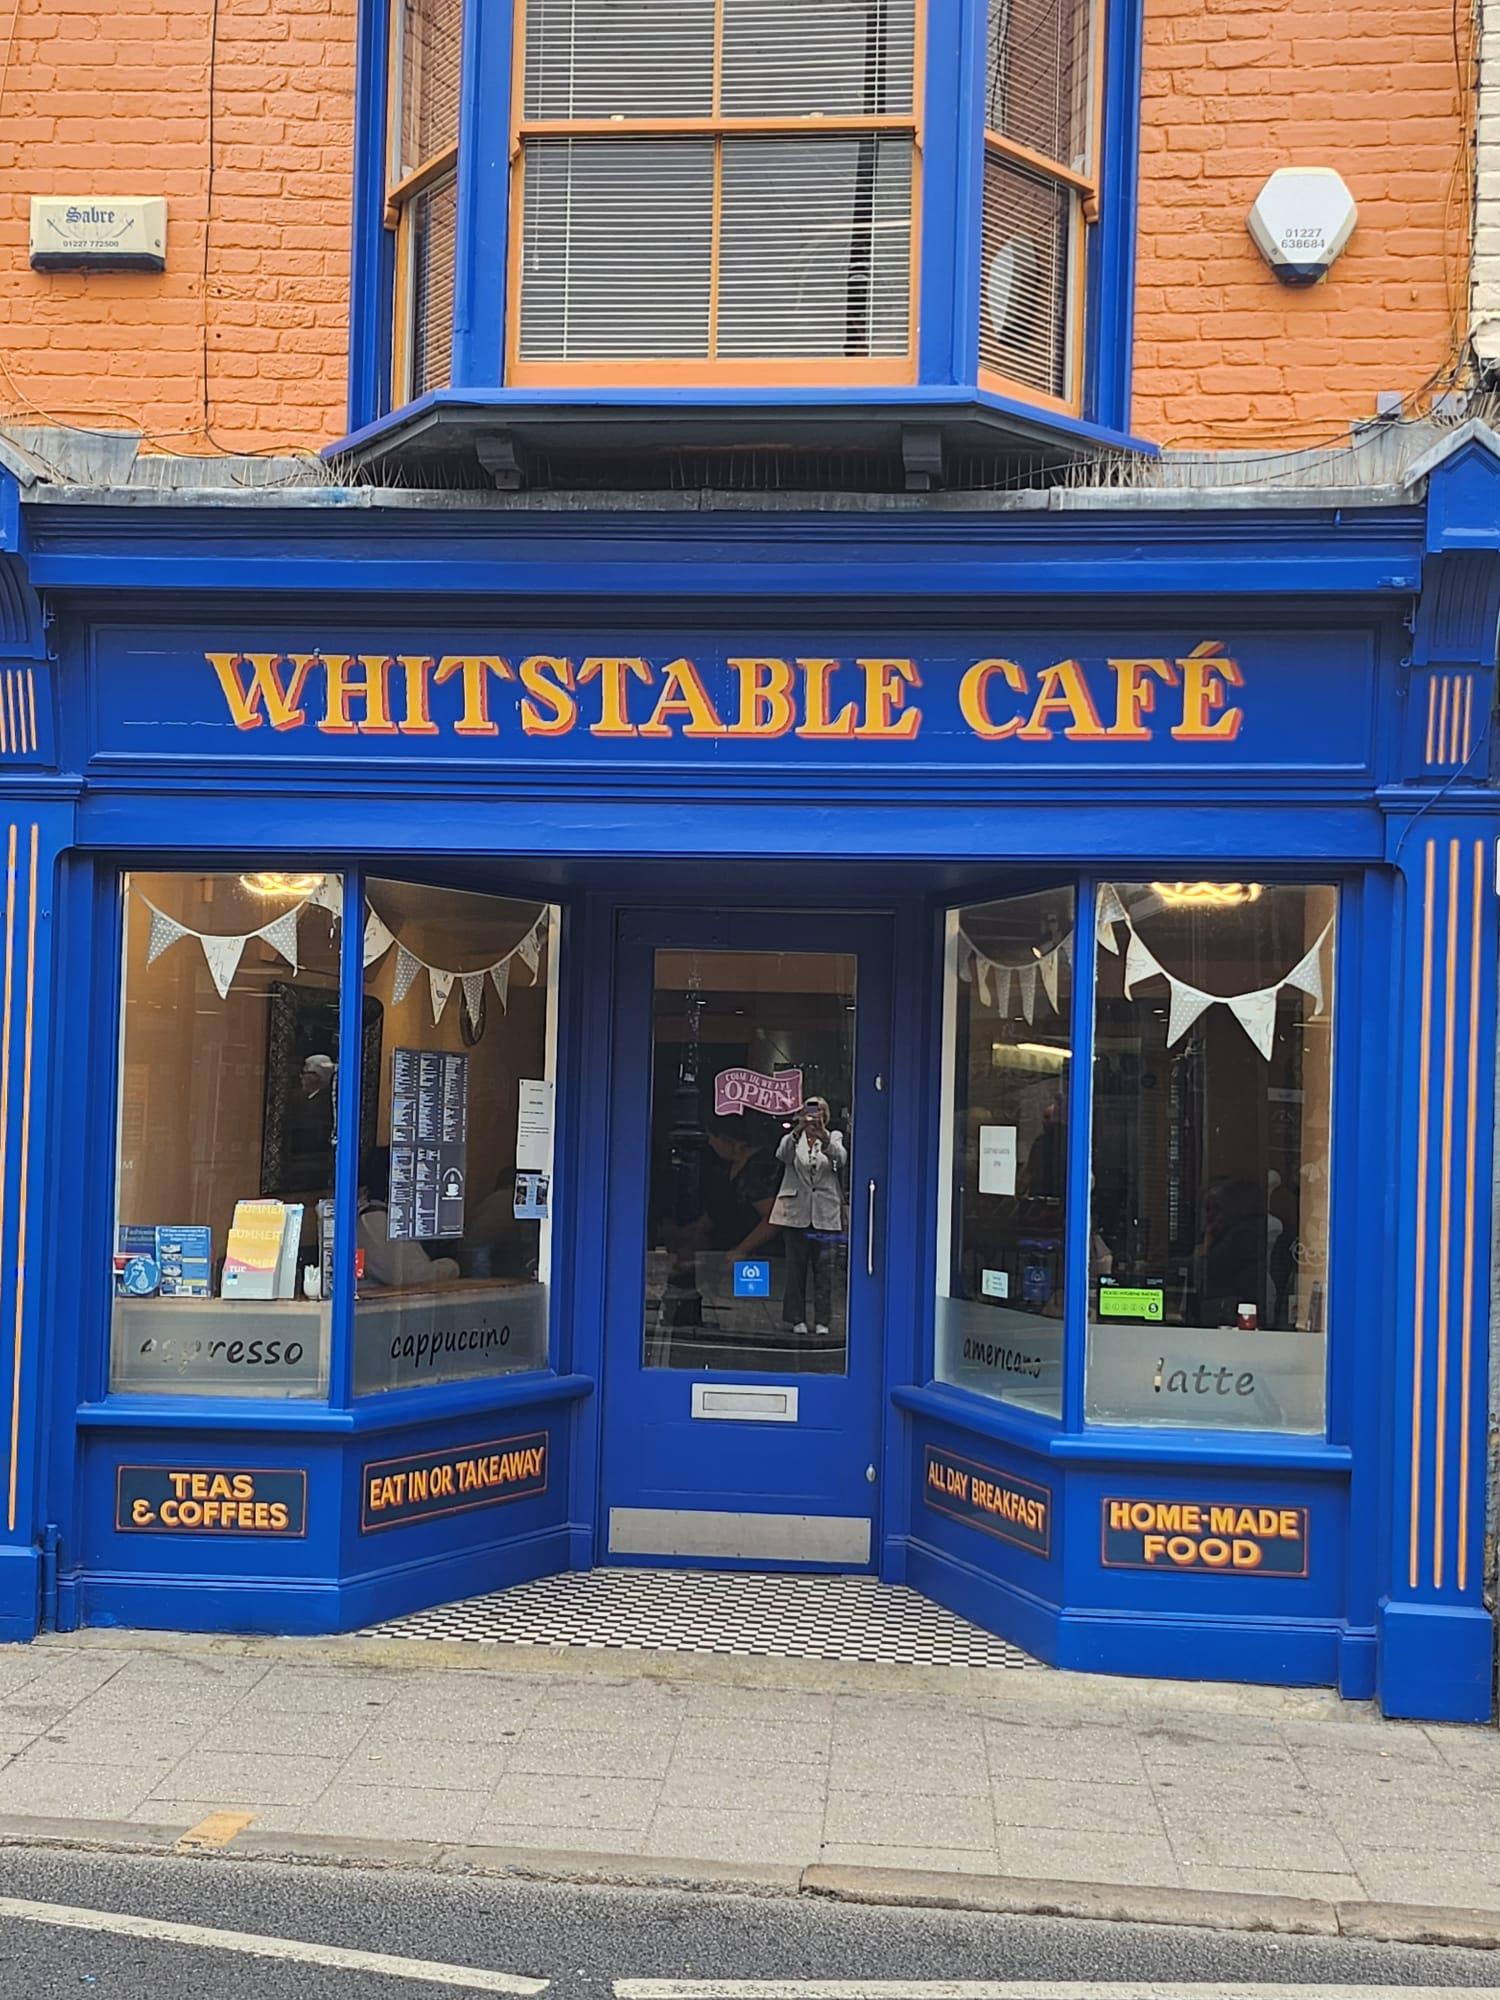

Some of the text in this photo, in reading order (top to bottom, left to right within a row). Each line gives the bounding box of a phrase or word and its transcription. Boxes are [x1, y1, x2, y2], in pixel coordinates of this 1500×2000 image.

[66, 206, 115, 223] Sabre
[1281, 239, 1325, 249] 638684
[1285, 228, 1322, 237] 01227
[204, 639, 1244, 742] WHITSTABLE CAFÉ
[724, 1080, 793, 1110] OPEN
[391, 1319, 510, 1368] cappuccino
[169, 1472, 255, 1501] TEAS
[370, 1446, 545, 1511] EAT IN OR TAKEAWAY
[928, 1460, 1046, 1533] ALL DAY BREAKFAST
[132, 1500, 290, 1530] & COFFEES
[1109, 1501, 1300, 1541] HOME-MADE
[1143, 1534, 1263, 1569] FOOD
